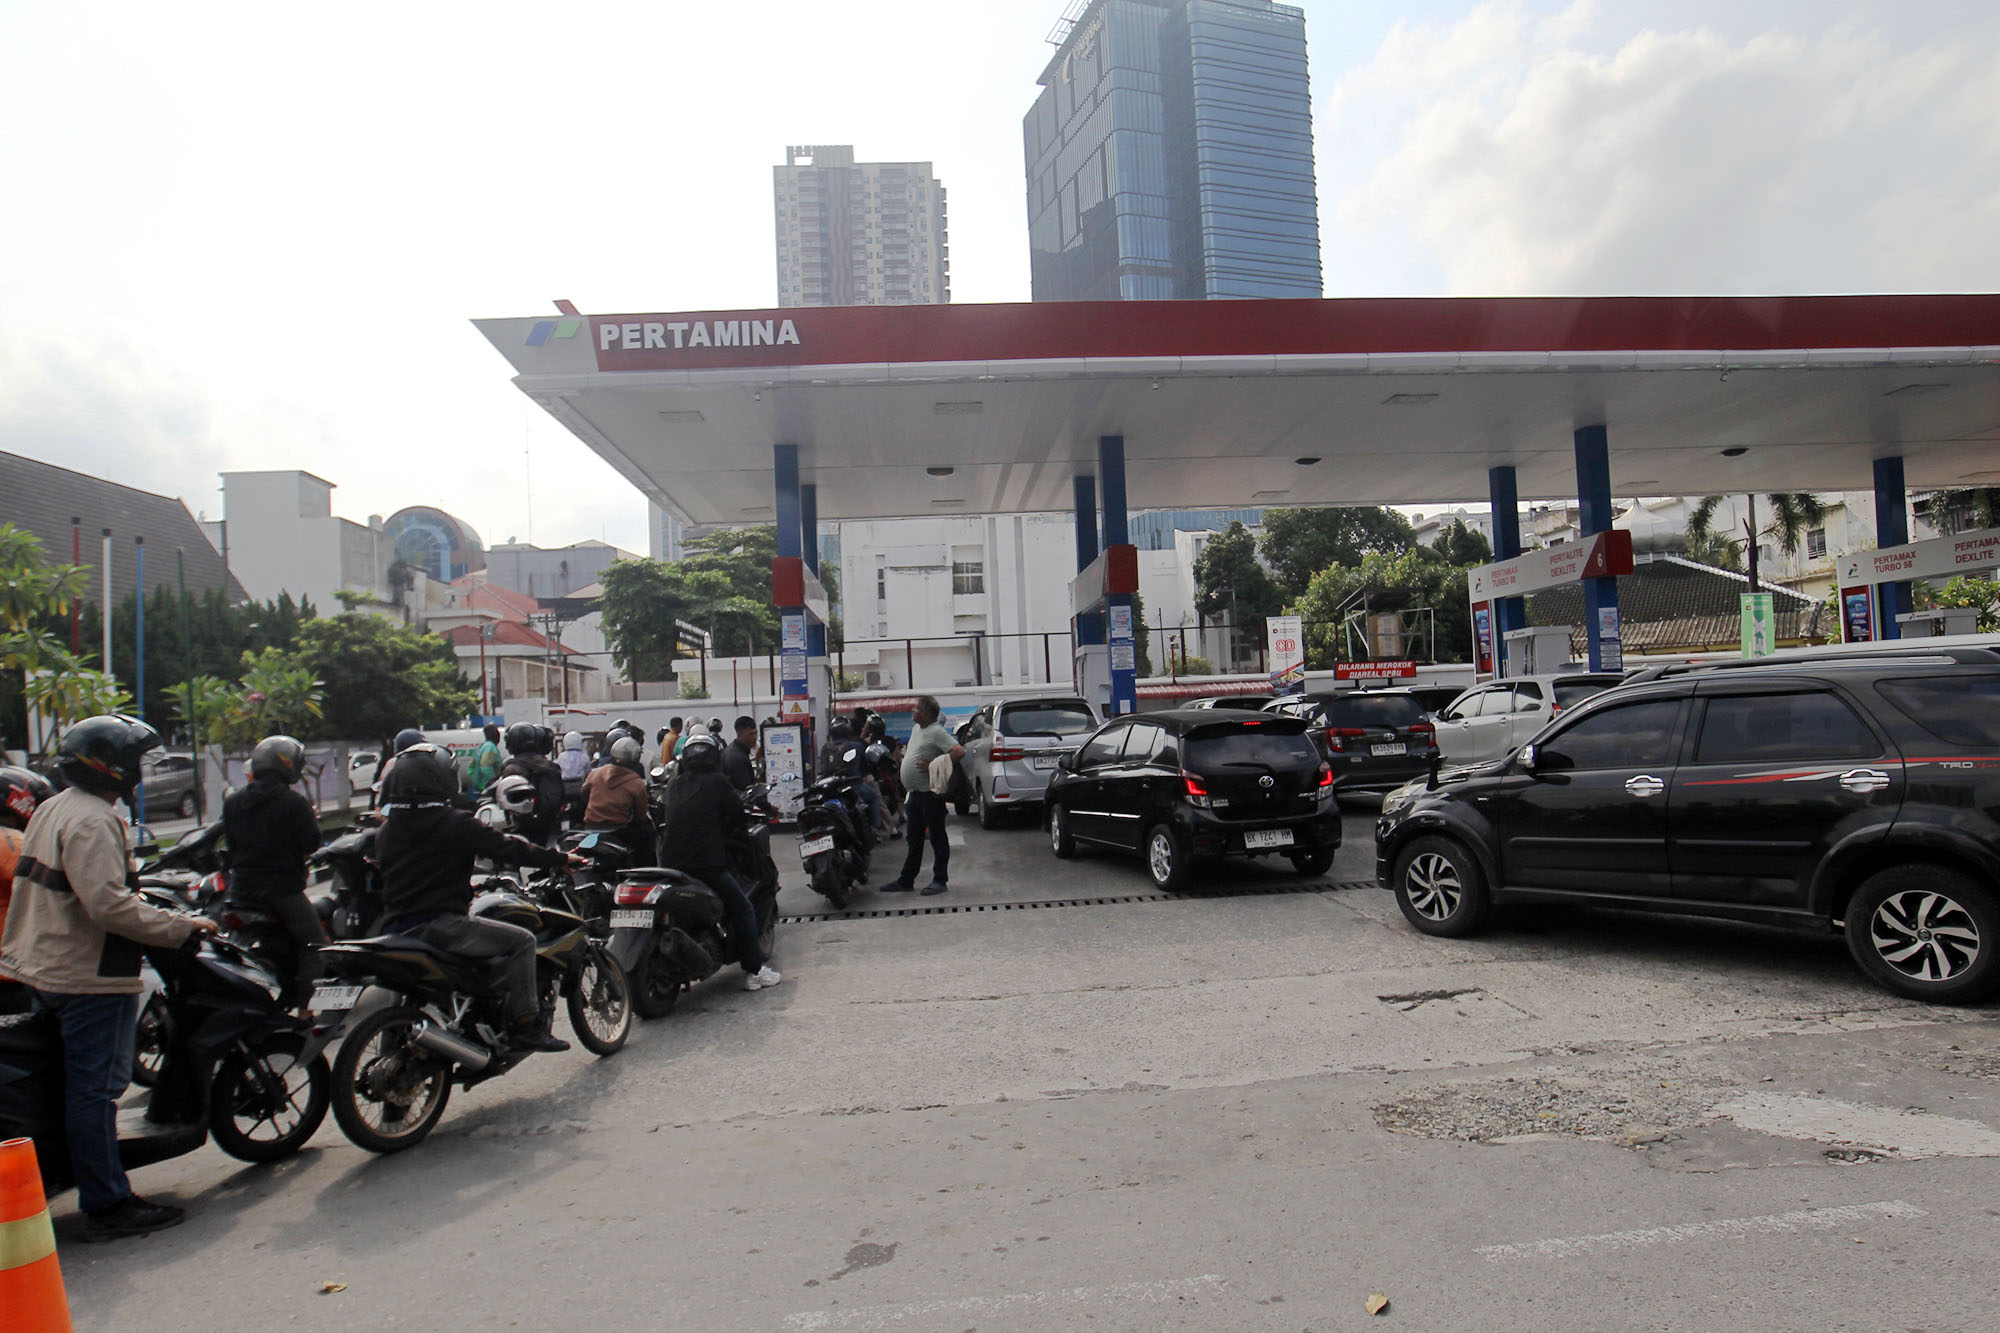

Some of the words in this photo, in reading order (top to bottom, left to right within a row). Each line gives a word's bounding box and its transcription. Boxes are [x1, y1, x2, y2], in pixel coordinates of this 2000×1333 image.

[600, 319, 800, 350] PERTAMINA
[1954, 536, 2000, 551] PERTAMA
[1597, 553, 1603, 567] 6
[1874, 551, 1917, 565] PERTAMAX
[1955, 549, 1994, 564] DEXLITE
[1875, 562, 1902, 574] TURBO
[1276, 639, 1295, 652] 80
[1338, 663, 1375, 671] DILARANG
[1376, 661, 1413, 669] MEROKOK
